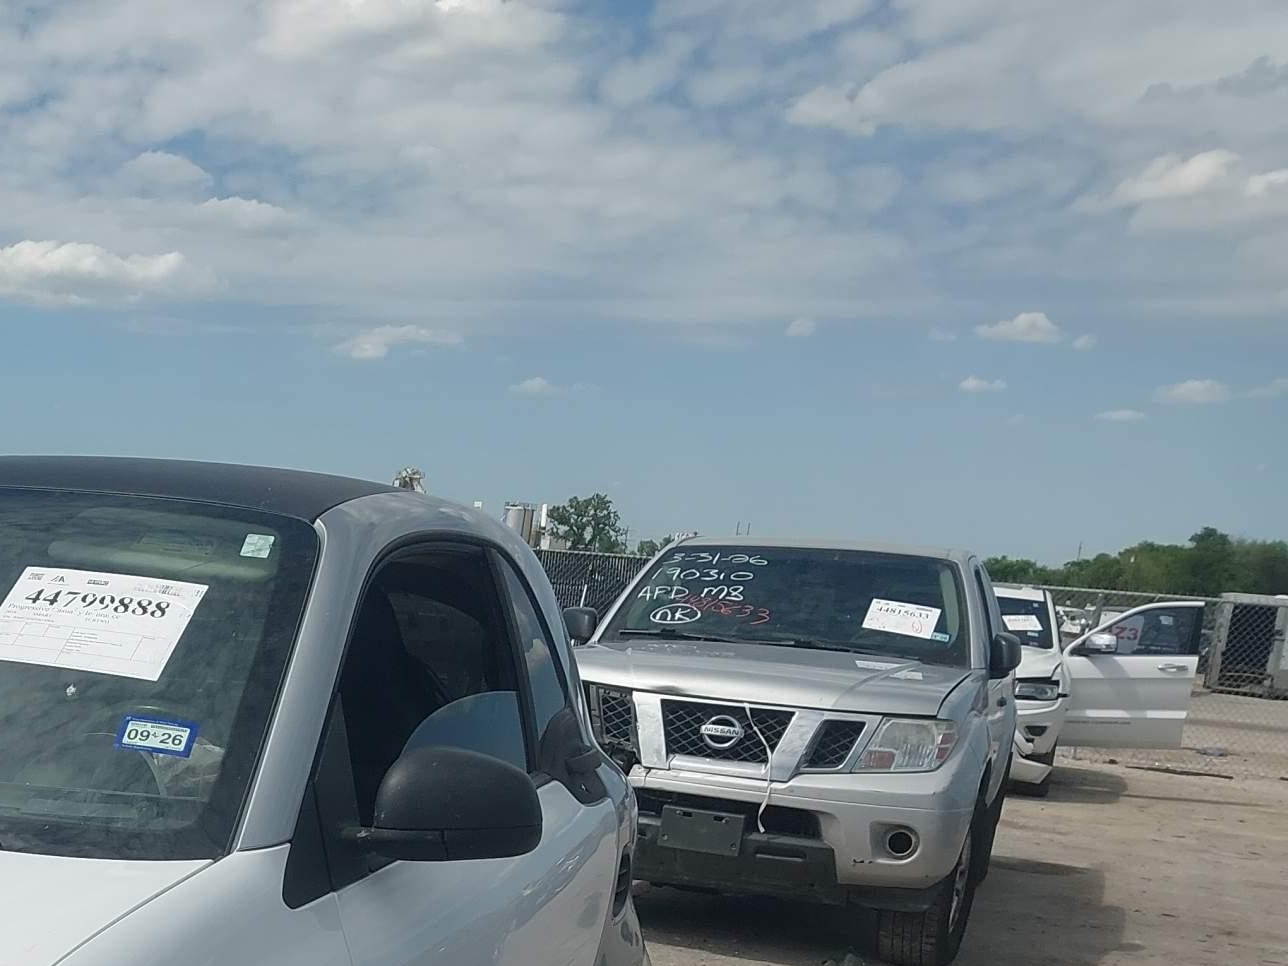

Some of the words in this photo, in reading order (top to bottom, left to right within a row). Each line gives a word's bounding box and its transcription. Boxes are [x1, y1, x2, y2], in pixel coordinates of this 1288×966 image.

[652, 567, 754, 581] 190310
[637, 586, 689, 600] AFD
[25, 588, 171, 619] 44799888
[1114, 626, 1139, 640] Z3
[127, 728, 151, 741] 09
[159, 732, 184, 746] 26
[703, 726, 740, 736] NISSAN
